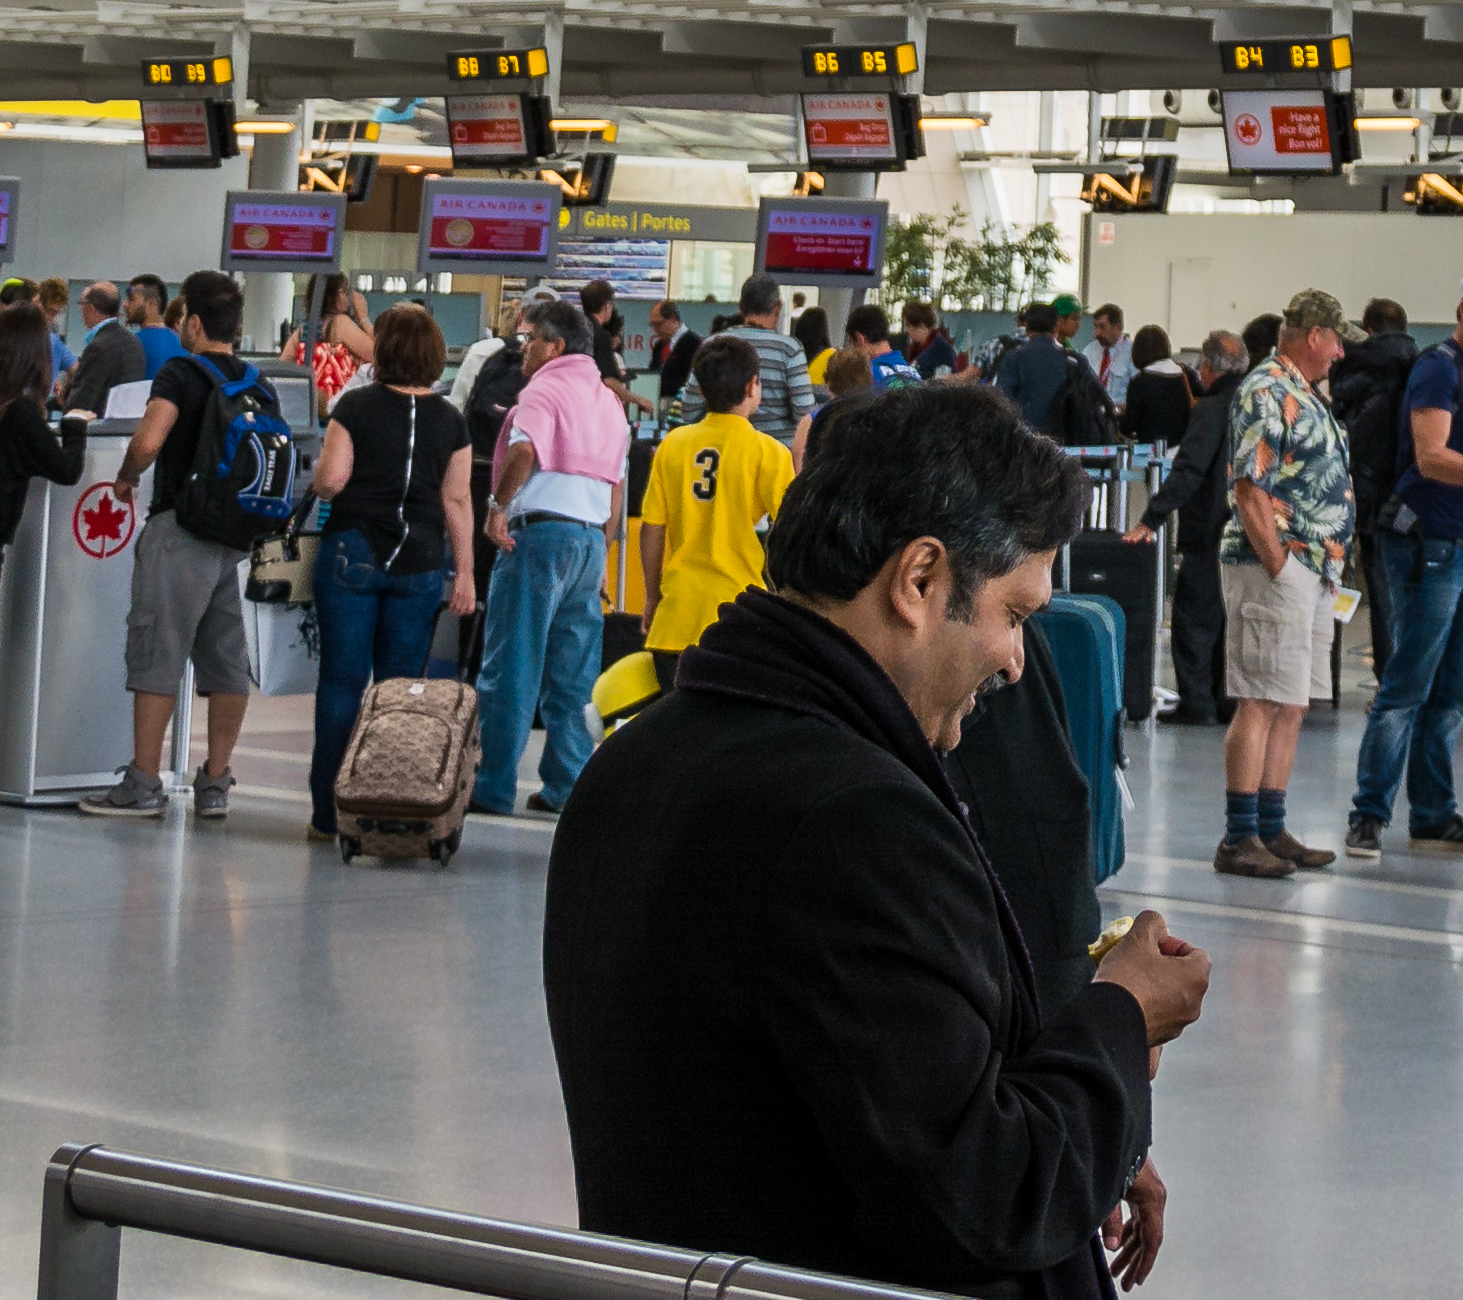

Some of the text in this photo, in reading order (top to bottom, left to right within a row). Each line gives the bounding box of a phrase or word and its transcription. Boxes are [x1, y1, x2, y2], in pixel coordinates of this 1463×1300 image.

[499, 55, 519, 76] B7
[814, 51, 887, 74] B6 B5
[1235, 45, 1319, 70] B4 B3
[186, 64, 206, 82] B9
[828, 101, 872, 110] CANADA
[1289, 111, 1312, 122] Have
[1278, 123, 1321, 138] nice flight
[439, 199, 526, 211] AIR CANADA
[583, 210, 628, 229] Gates
[641, 213, 691, 232] Portes
[691, 446, 721, 503] 3
